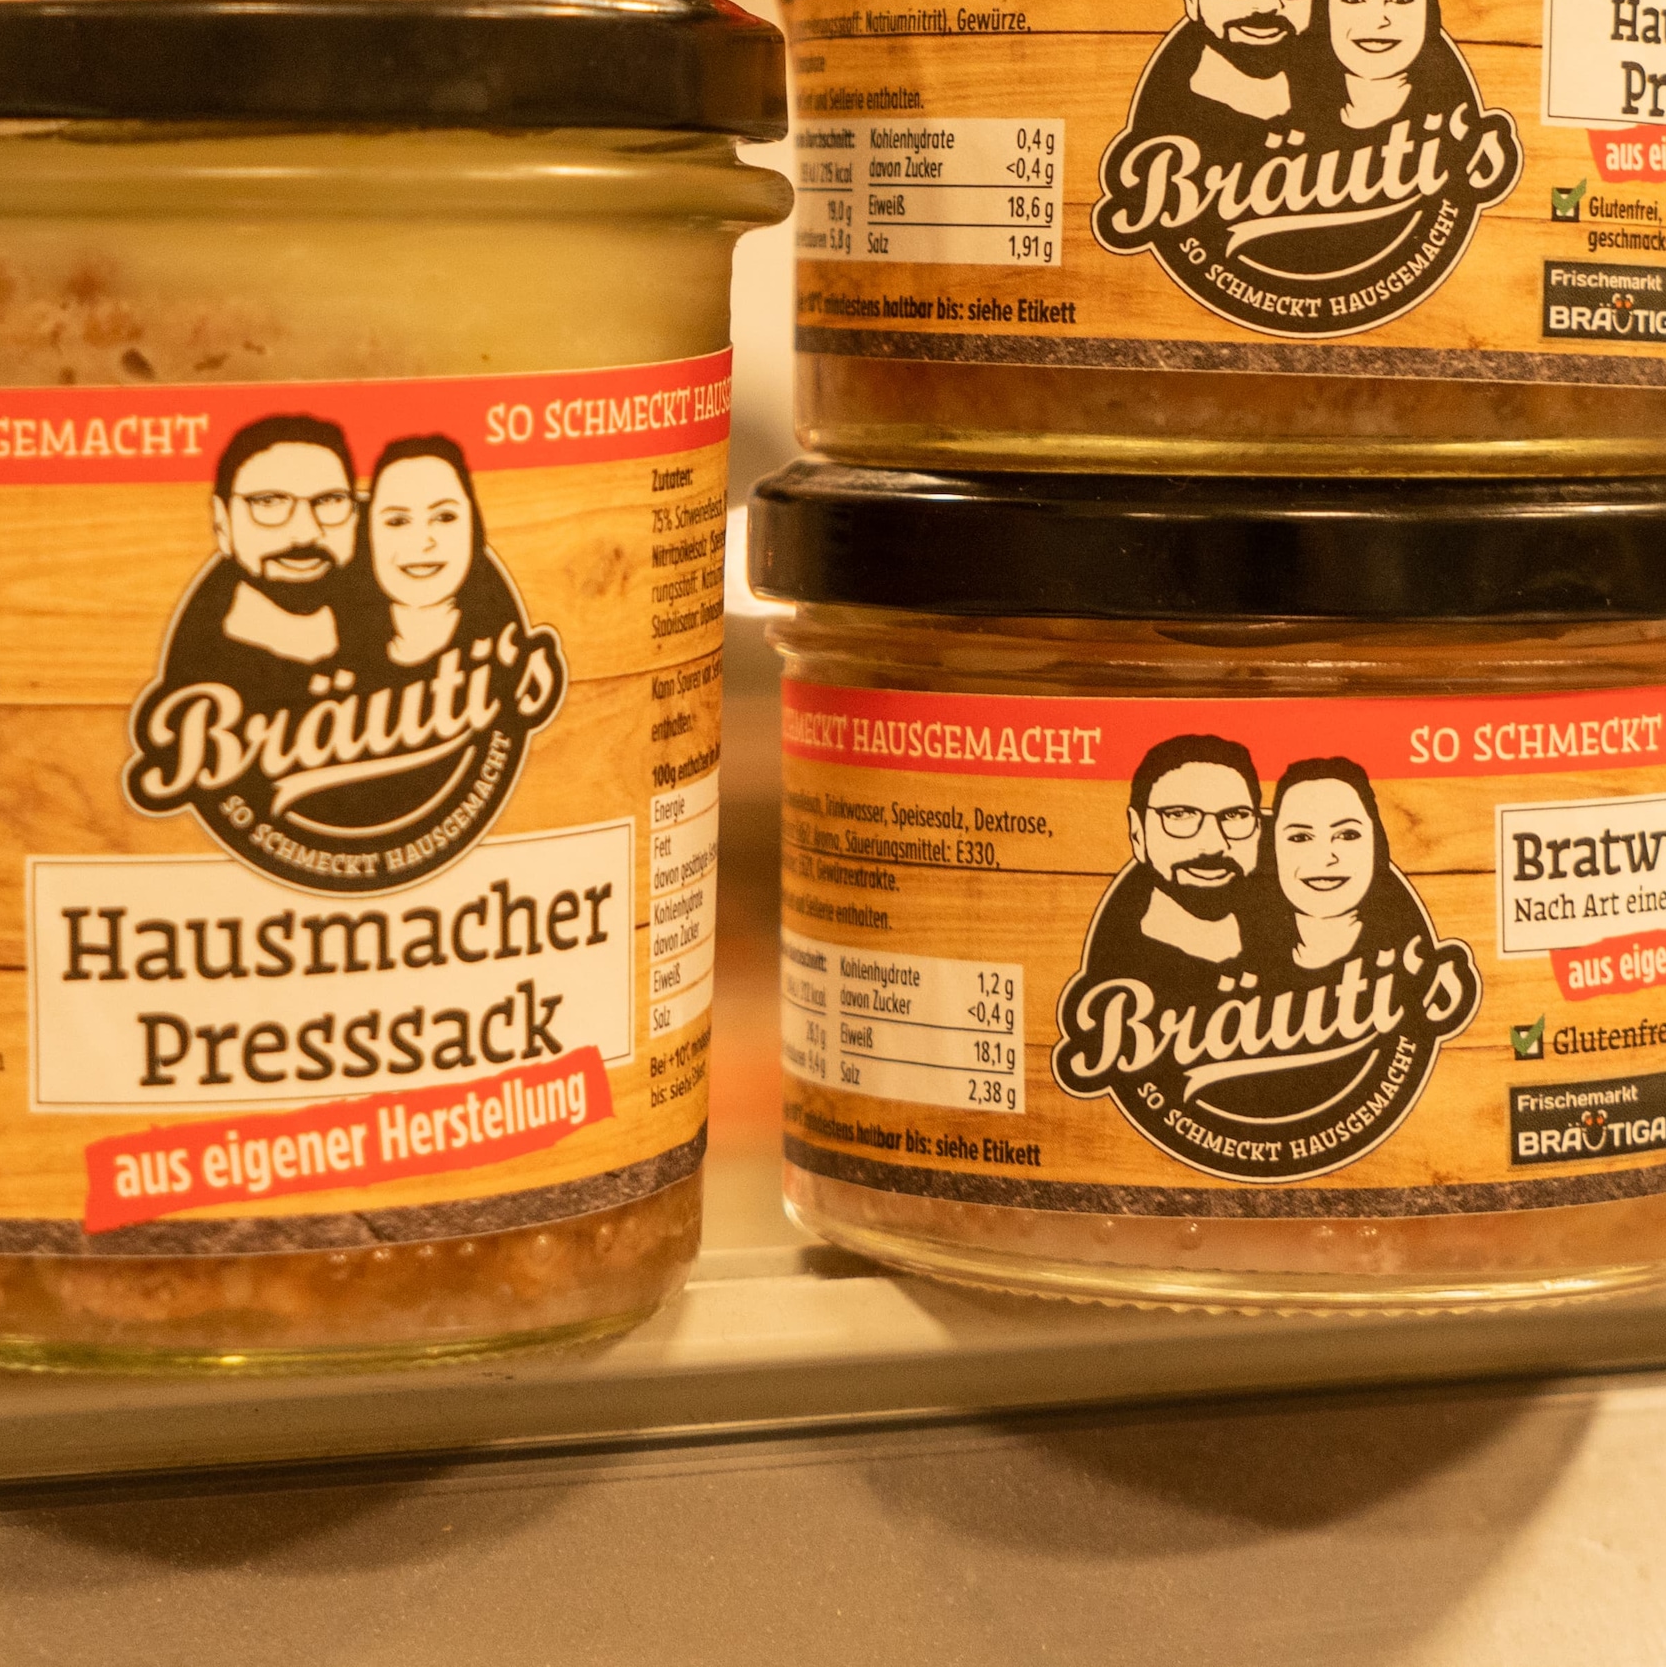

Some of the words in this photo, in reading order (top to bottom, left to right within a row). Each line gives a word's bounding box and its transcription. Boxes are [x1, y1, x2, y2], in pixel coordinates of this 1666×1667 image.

[957, 8, 1032, 33] Gewürze,
[866, 86, 925, 110] enthalten.
[870, 128, 955, 155] Kohlenhydrate
[1017, 128, 1041, 154] 0,4
[1044, 133, 1055, 155] g
[1605, 142, 1643, 171] aus
[869, 156, 901, 178] davon
[904, 157, 944, 179] Zucker
[1005, 157, 1041, 184] <0,4
[1044, 166, 1055, 184] g
[868, 194, 906, 216] Eiweiß
[1007, 195, 1041, 220] 18,6
[1044, 200, 1054, 223] g
[1588, 195, 1663, 225] Glutenfrei,
[867, 231, 889, 253] Salz
[1008, 235, 1041, 260] 1,91
[1043, 240, 1053, 262] g
[1178, 237, 1207, 266] SO
[1204, 261, 1322, 318] SCHMECKT
[1329, 198, 1460, 317] HAUSGEMACHT
[1550, 268, 1663, 292] Frischemarkt
[882, 294, 934, 319] haltbar
[937, 295, 964, 320] bis:
[968, 297, 1013, 322] siehe
[1017, 299, 1076, 324] Etikett
[485, 401, 534, 445] SO
[544, 386, 693, 441] SCHMECKT
[651, 466, 694, 493] Zutaten:
[651, 675, 675, 701] Kann
[851, 717, 1101, 765] HAUSGEMACHT
[1409, 725, 1460, 764] SO
[1473, 713, 1663, 762] SCHMECKT
[218, 793, 255, 830] SO
[249, 822, 379, 877] SCHMECKT
[386, 729, 512, 875] HAUSGEMACHT
[654, 793, 685, 823] Energie
[825, 792, 888, 827] Trinkwasser,
[891, 802, 970, 832] Speisesalz,
[973, 807, 1054, 838] Dextrose,
[654, 834, 672, 860] Fett
[845, 830, 952, 864] Säuerungsmittel:
[955, 841, 1001, 869] E330,
[654, 866, 680, 890] davon
[835, 902, 893, 931] enthalten.
[1513, 892, 1577, 923] Nach
[1582, 891, 1620, 918] Art
[60, 877, 614, 983] Hausmacher
[654, 933, 679, 957] davon
[654, 962, 681, 993] Eiweiß
[840, 955, 921, 988] Kohlenhydrate
[978, 972, 1000, 997] 1,2
[1004, 979, 1014, 1001] g
[1568, 957, 1614, 990] aus
[653, 1004, 671, 1031] Salz
[840, 985, 870, 1009] davon
[873, 989, 912, 1016] Zucker
[967, 1002, 1001, 1027] <0,4
[1004, 1009, 1014, 1031] g
[137, 977, 565, 1087] Presssack
[840, 1022, 874, 1049] Eiweiß
[974, 1041, 1003, 1066] 18,1
[1006, 1049, 1016, 1070] g
[650, 1052, 667, 1078] Bei
[650, 1083, 668, 1108] bis:
[840, 1060, 861, 1085] Salz
[968, 1079, 1003, 1104] 2,38
[1007, 1088, 1016, 1110] g
[1137, 1081, 1165, 1111] SO
[1163, 1109, 1283, 1162] SCHMECKT
[1290, 1034, 1419, 1160] HAUSGEMACHT
[1517, 1084, 1639, 1113] Frischemarkt
[113, 1147, 192, 1200] aus
[201, 1122, 369, 1193] eigener
[376, 1068, 588, 1163] Herstellung
[856, 1119, 903, 1151] haltbar
[906, 1128, 932, 1156] bis:
[935, 1134, 979, 1161] siehe
[982, 1138, 1041, 1167] Etikett
